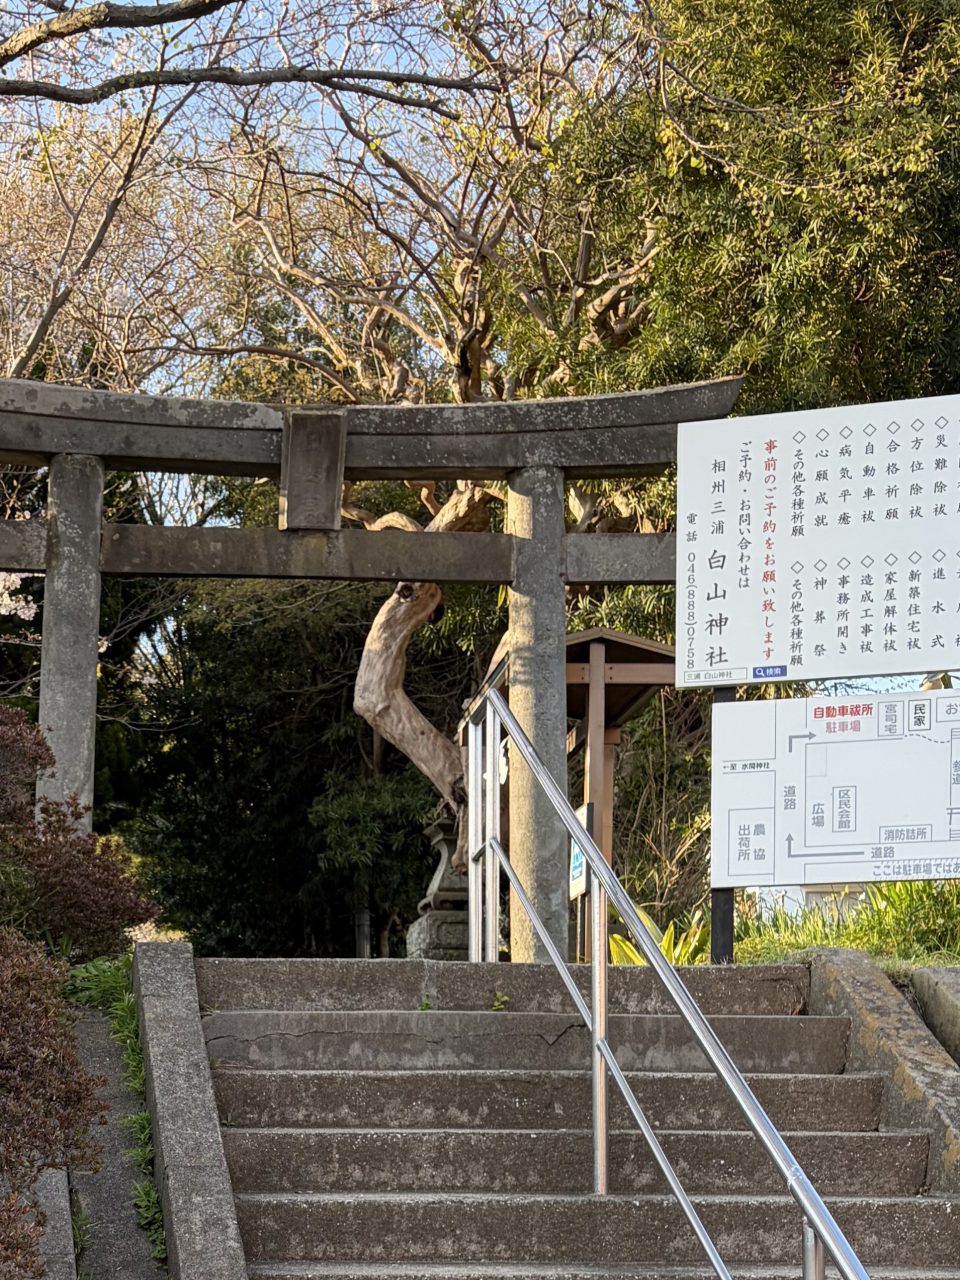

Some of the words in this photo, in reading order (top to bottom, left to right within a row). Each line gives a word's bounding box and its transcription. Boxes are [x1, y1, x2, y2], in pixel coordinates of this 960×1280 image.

[737, 440, 753, 589] ご予約・お問い合わせは
[790, 448, 806, 537] その他各種祈願
[813, 449, 830, 528] 心願成就
[837, 444, 853, 525] 病気平癒
[861, 441, 876, 523] 自動車祓
[884, 439, 901, 520] 合格祈願
[909, 436, 925, 519] 方位除祓
[933, 433, 949, 517] 災難除祓
[685, 512, 698, 543] 電話
[761, 438, 778, 661] 事前のご予約をお願い致します
[789, 578, 805, 667] その他各種祈願
[836, 574, 851, 655] 事務所開き
[859, 572, 875, 654] 造成工事祓
[882, 570, 899, 652] 家屋解体祓
[906, 569, 922, 651] 新築住宅祓
[930, 567, 947, 649] 進水式
[813, 702, 874, 719] 自動車祓所
[825, 719, 861, 734] 駐車場
[885, 704, 897, 734] 宮司宅
[913, 703, 926, 727] 民家
[783, 785, 797, 811] 道路
[811, 802, 825, 828] 広場
[838, 789, 850, 829] 区民会館
[884, 828, 926, 841] 消防詰所
[870, 845, 895, 859] 道路
